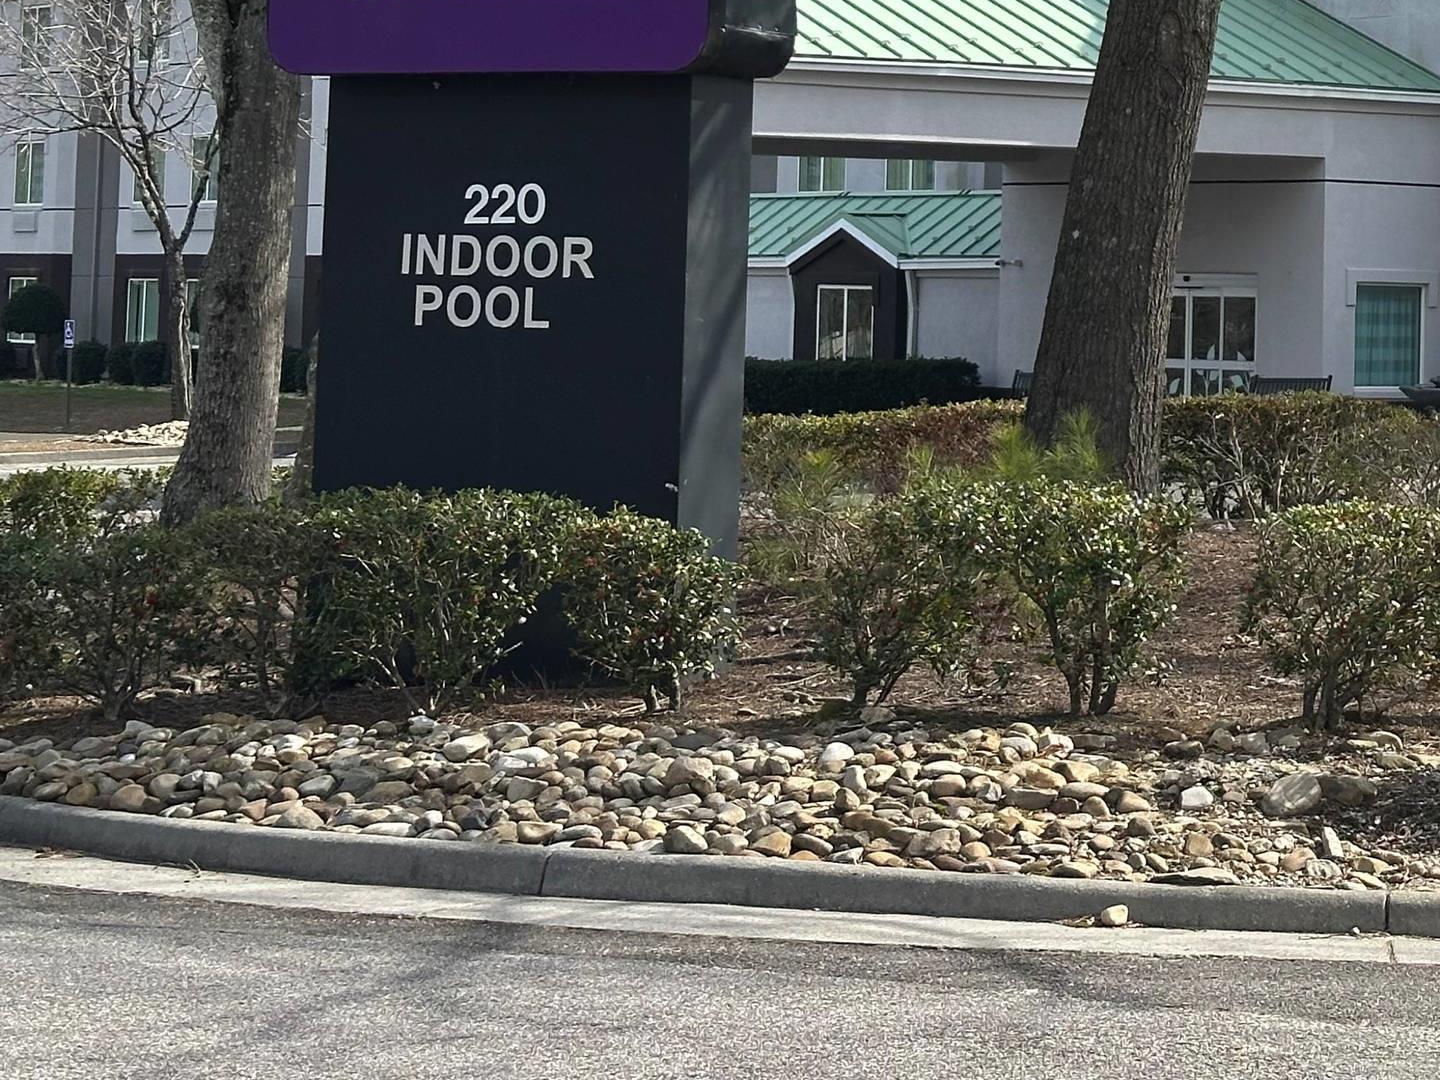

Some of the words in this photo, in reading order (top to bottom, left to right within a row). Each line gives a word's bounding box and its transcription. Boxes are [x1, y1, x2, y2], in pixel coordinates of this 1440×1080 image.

[463, 182, 547, 225] 220
[400, 233, 595, 279] INDOOR
[414, 284, 550, 329] POOL
